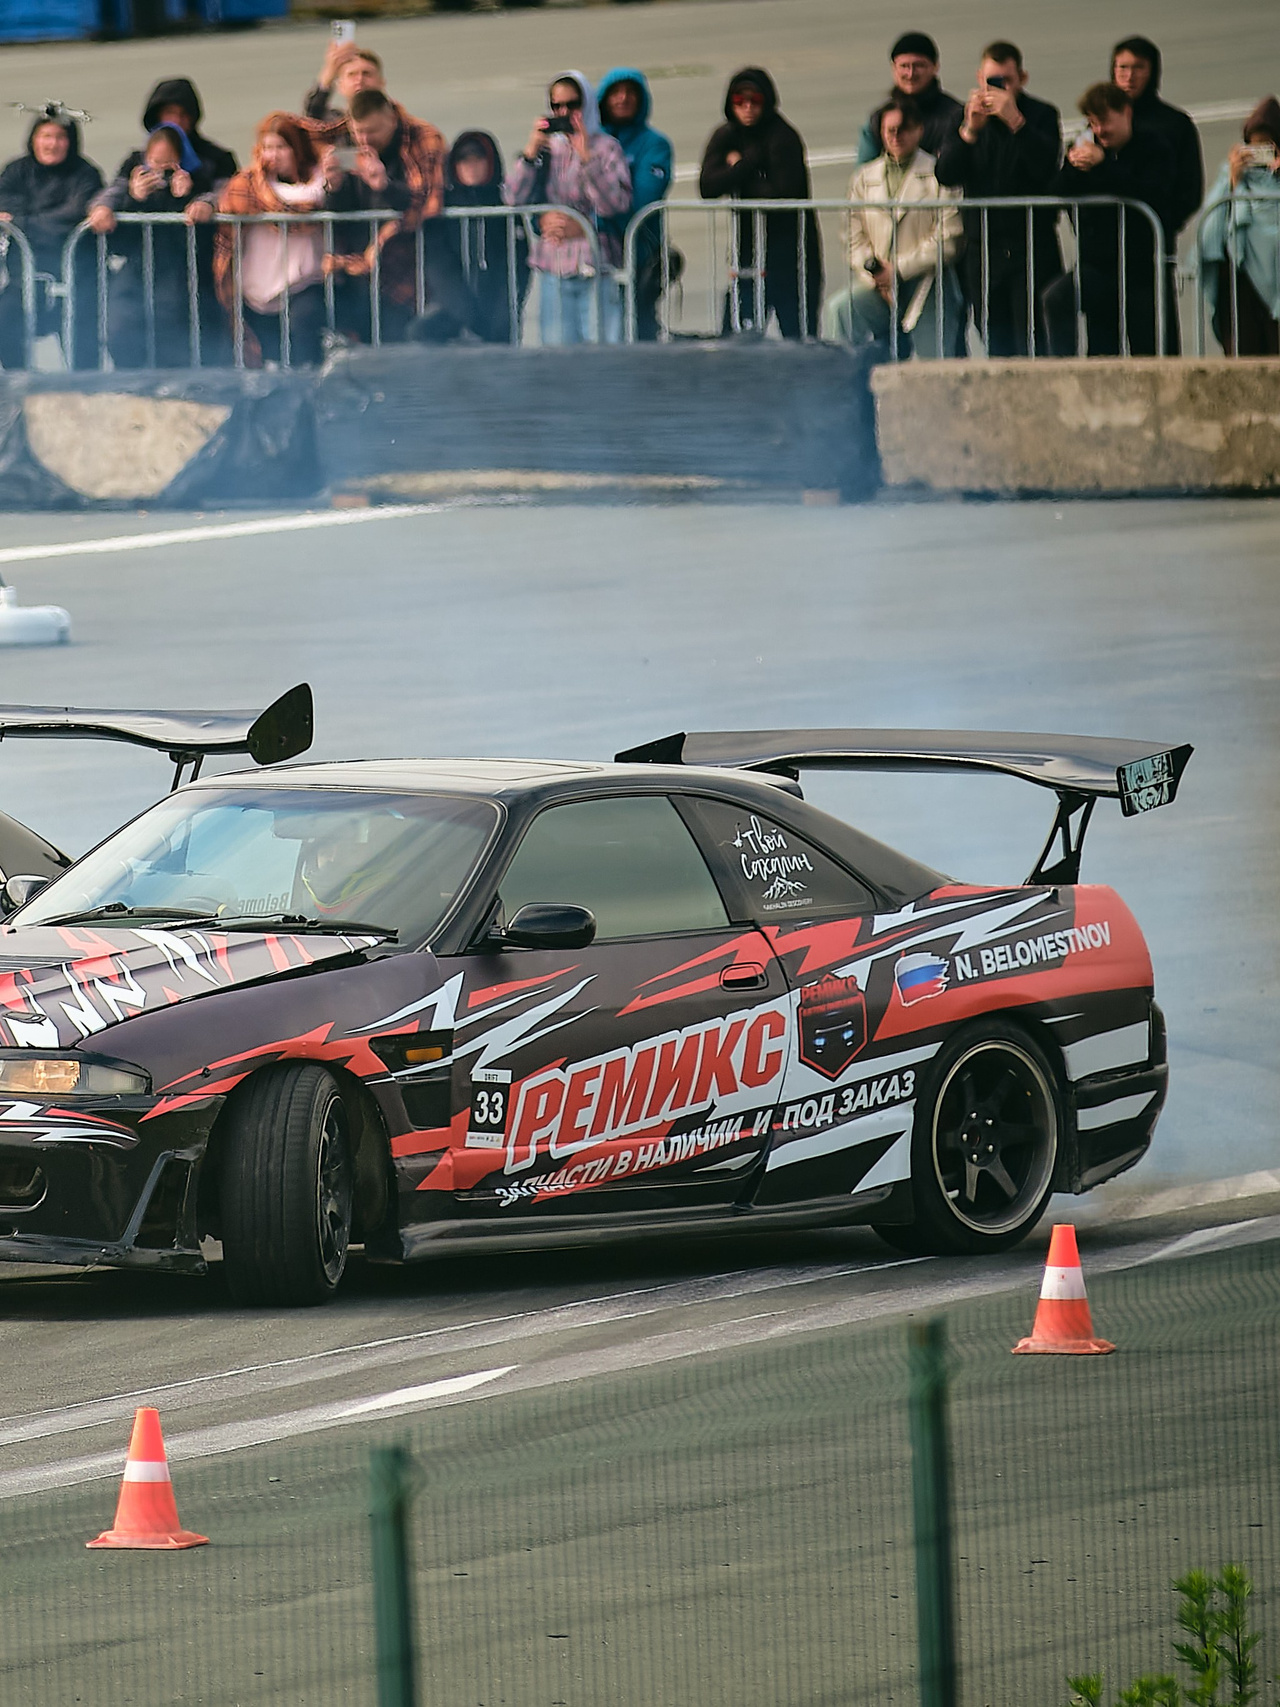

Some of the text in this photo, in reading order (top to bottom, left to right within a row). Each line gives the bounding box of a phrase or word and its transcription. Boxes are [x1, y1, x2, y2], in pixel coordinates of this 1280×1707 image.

[741, 814, 788, 854] Твой
[740, 853, 814, 882] Сахалин
[954, 920, 1111, 981] N. BELOMESTNOV
[474, 1090, 504, 1125] 33
[506, 1007, 788, 1173] РЕМИКС
[494, 1069, 917, 1208] ЗАПЧАСТИ В НАЛИЧИИ И ПОД ЗАКАЗ
